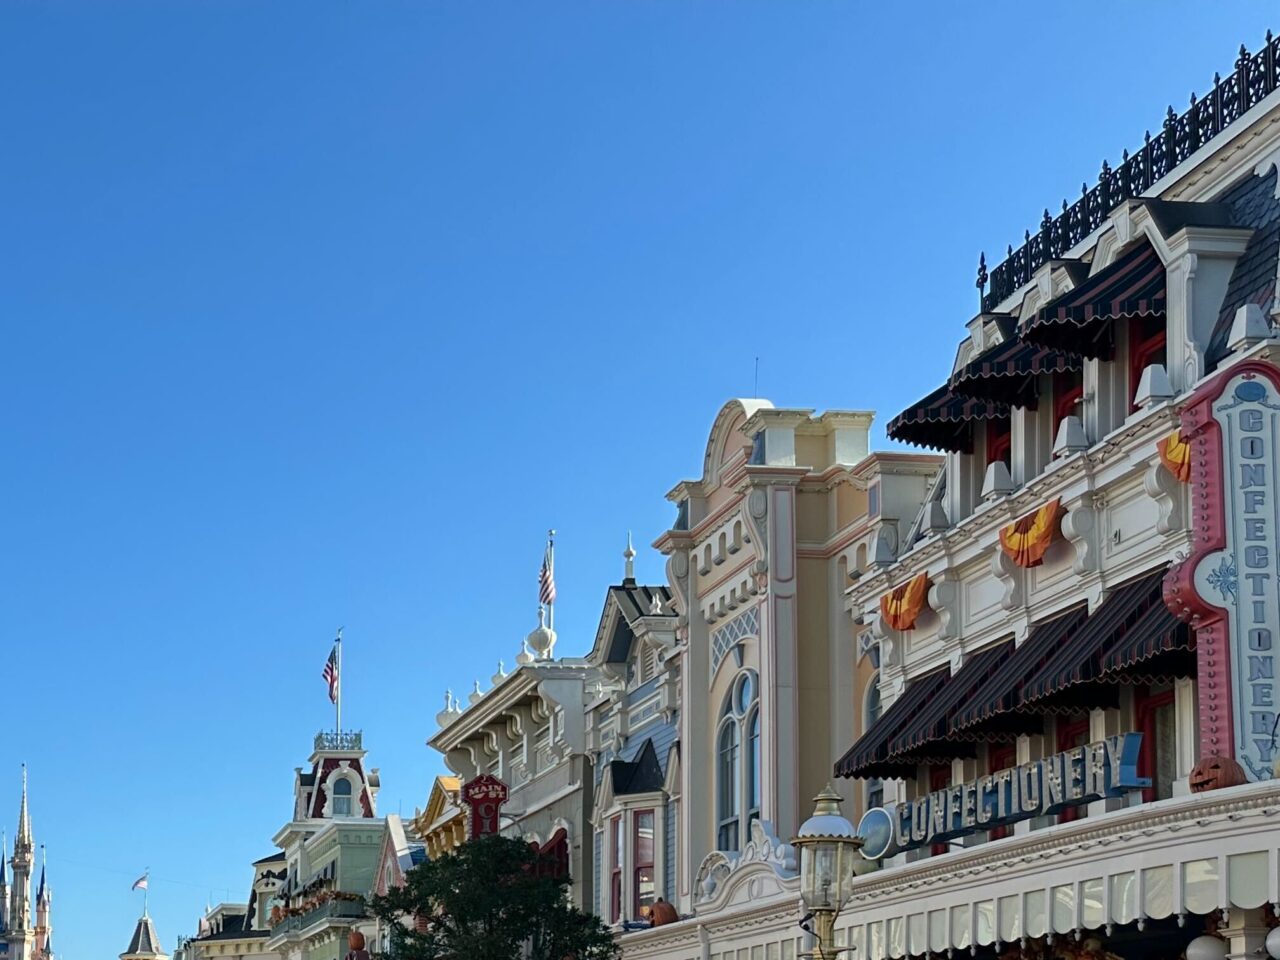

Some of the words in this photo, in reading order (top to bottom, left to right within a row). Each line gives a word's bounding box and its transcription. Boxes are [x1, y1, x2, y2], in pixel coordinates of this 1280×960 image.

[1238, 409, 1279, 762] CONFECTIONERY
[468, 784, 502, 796] MAIN
[894, 732, 1128, 848] CONFECTIONERY
